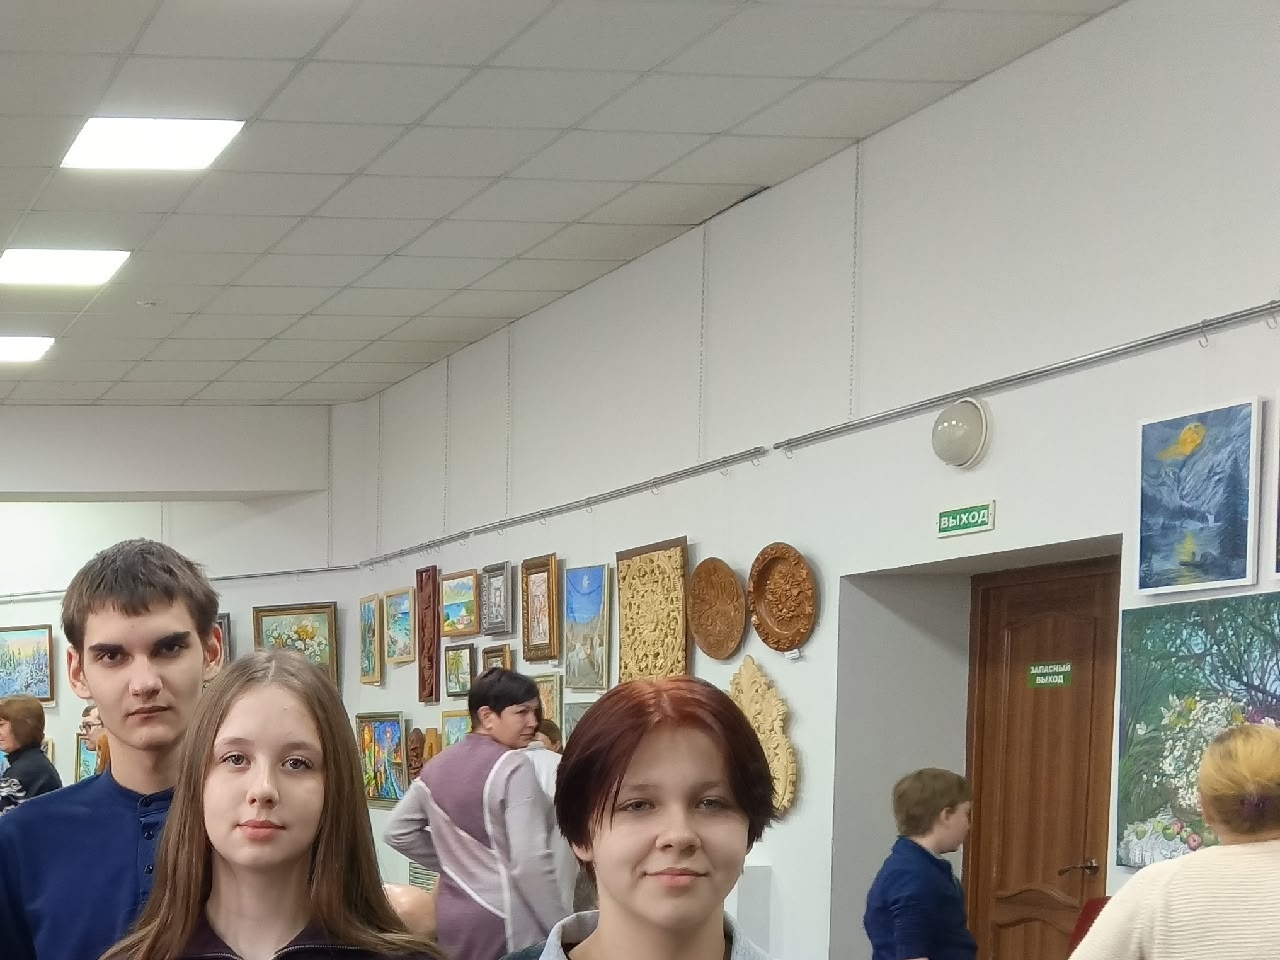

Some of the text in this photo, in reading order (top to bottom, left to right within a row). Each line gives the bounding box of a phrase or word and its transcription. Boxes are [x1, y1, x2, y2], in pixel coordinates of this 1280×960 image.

[940, 509, 989, 529] ВЫХОД
[1030, 663, 1071, 674] ЗАПАСНЫЙ
[1035, 675, 1064, 684] ВЫХОД
